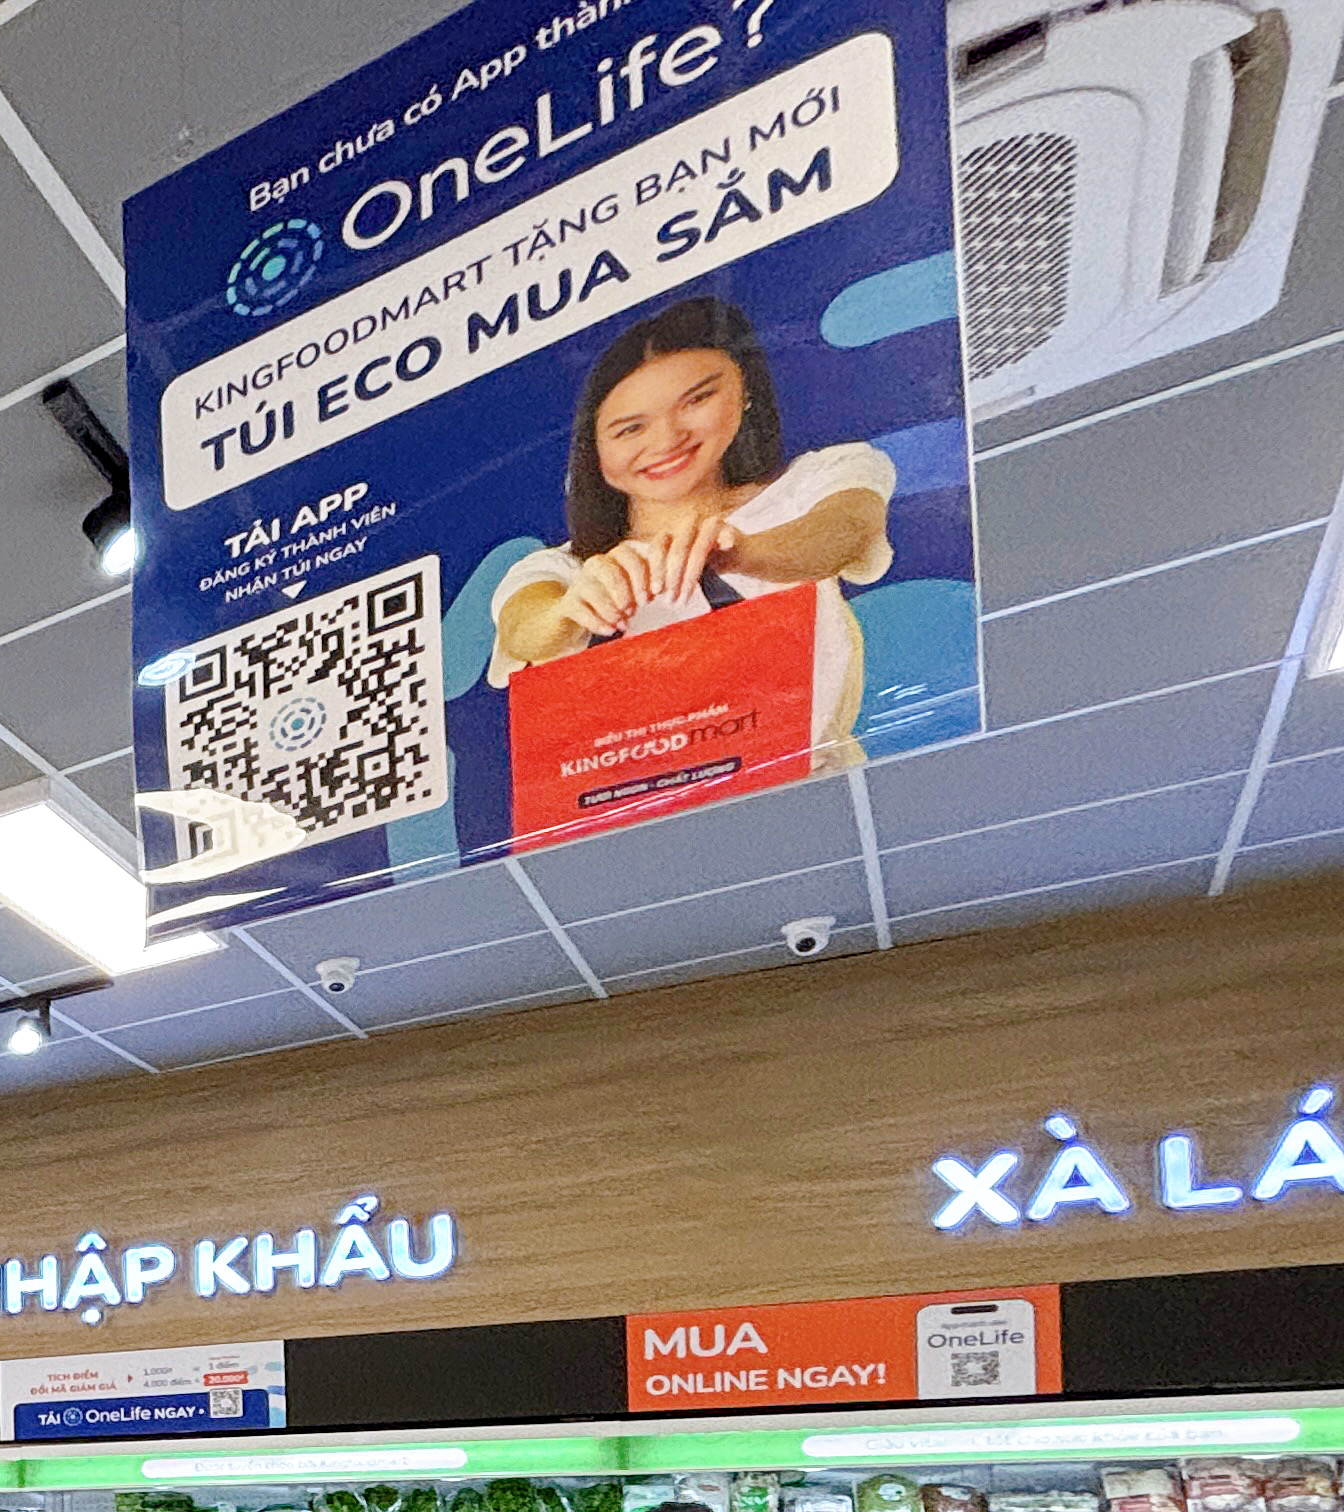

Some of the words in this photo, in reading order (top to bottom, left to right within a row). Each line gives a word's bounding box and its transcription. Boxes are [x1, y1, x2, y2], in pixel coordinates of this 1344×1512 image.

[249, 164, 310, 212] Bạn
[318, 117, 396, 173] chưa
[403, 83, 443, 127] có
[450, 44, 527, 101] App
[536, 0, 630, 49] thàn
[341, 0, 775, 250] OneLife?
[195, 257, 490, 419] KINGFOODMART
[505, 198, 620, 267] TẶNG
[636, 137, 730, 206] BẠN
[750, 85, 842, 156] MỚI
[202, 398, 297, 472] TÚI
[318, 336, 442, 424] ECO
[468, 259, 630, 354] MUA
[656, 149, 831, 262] SẮM
[199, 562, 250, 592] ĐĂNG
[281, 523, 346, 559] THÀNH
[351, 502, 396, 531] VIÊN
[224, 518, 280, 558] TẢI
[291, 482, 368, 534] APP
[282, 559, 310, 580] TÚI
[316, 536, 368, 568] NGAY
[931, 1112, 1130, 1232] XÀ
[1159, 1084, 1344, 1211] LÁ
[198, 1195, 456, 1299] KHẨU
[644, 1322, 768, 1362] MUA
[645, 1367, 768, 1397] ONLINE
[777, 1362, 887, 1391] NGAY!
[928, 1330, 1024, 1348] OneLife
[38, 1409, 61, 1426] TẢI
[85, 1407, 151, 1424] OneLife
[154, 1405, 195, 1419] NGAY
